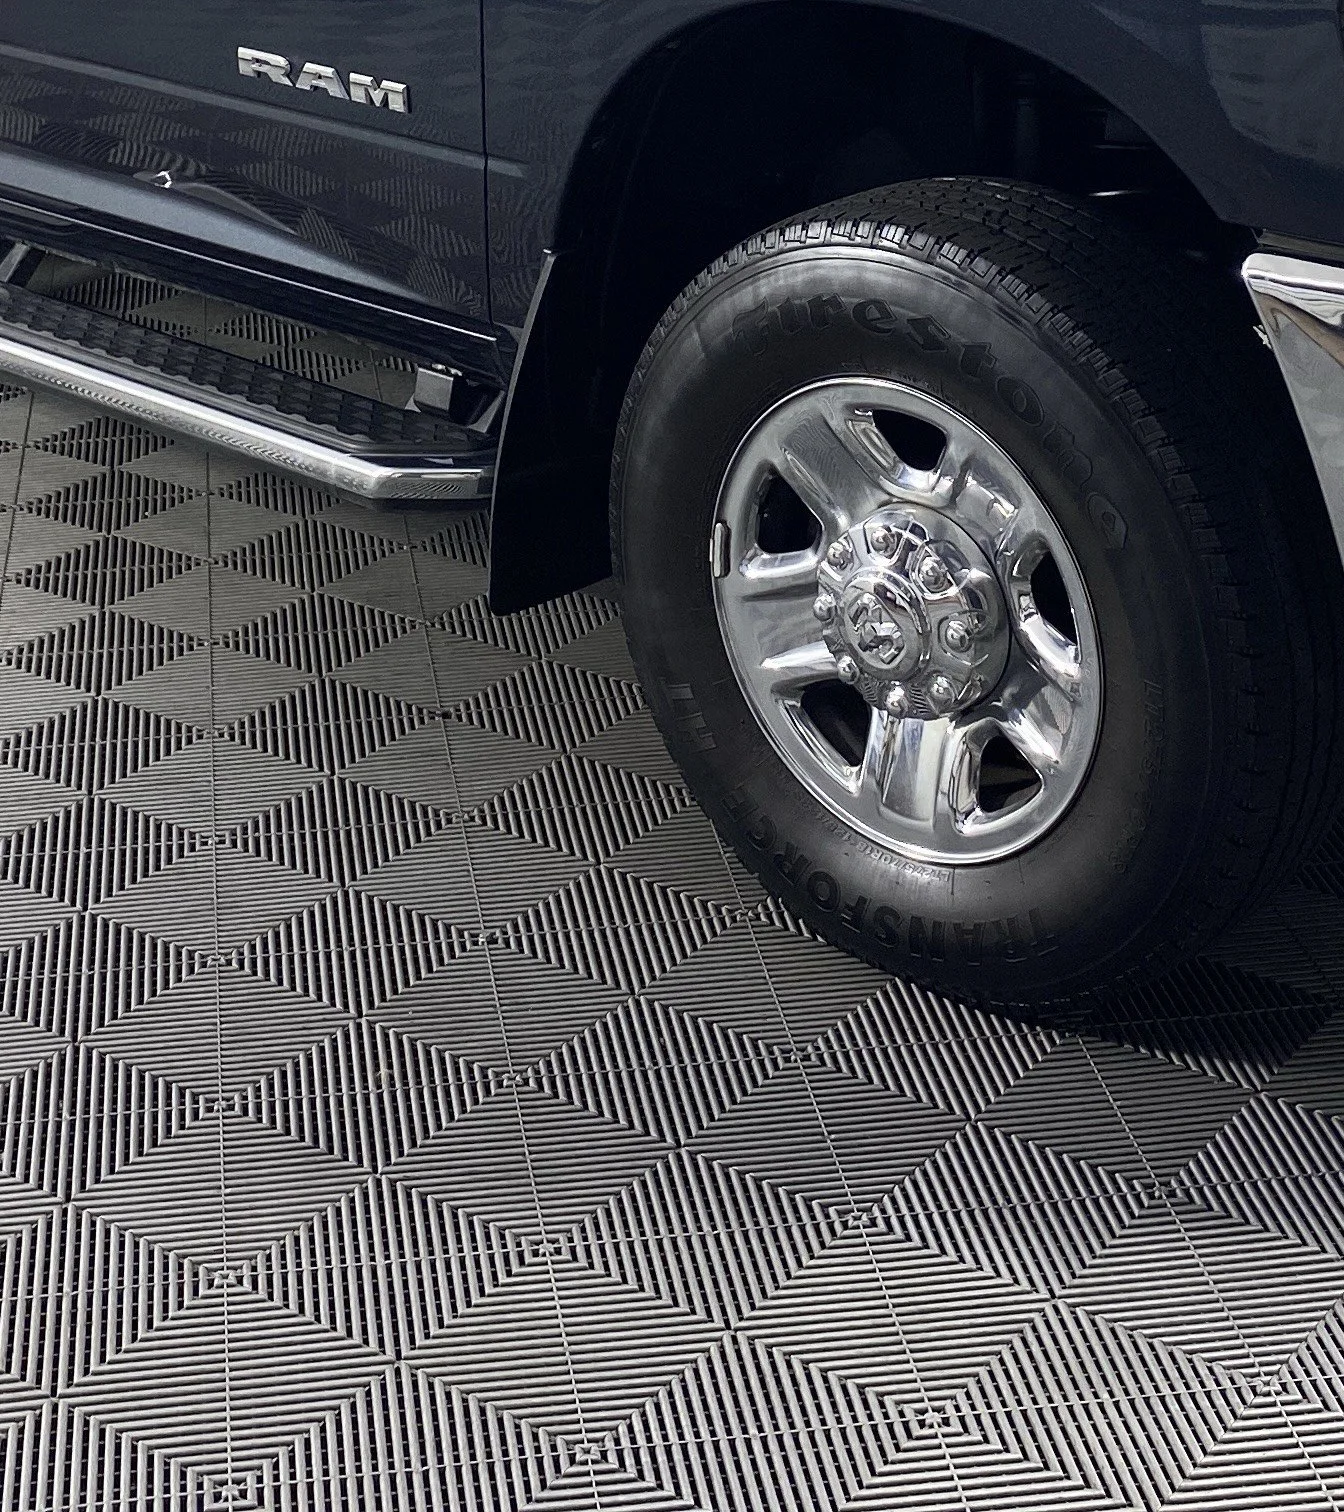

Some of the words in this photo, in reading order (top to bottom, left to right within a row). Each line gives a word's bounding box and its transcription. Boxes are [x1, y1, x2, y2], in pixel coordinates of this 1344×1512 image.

[237, 46, 411, 113] RAM
[732, 293, 1128, 550] Firestone
[720, 781, 1059, 966] TRANSFORCE
